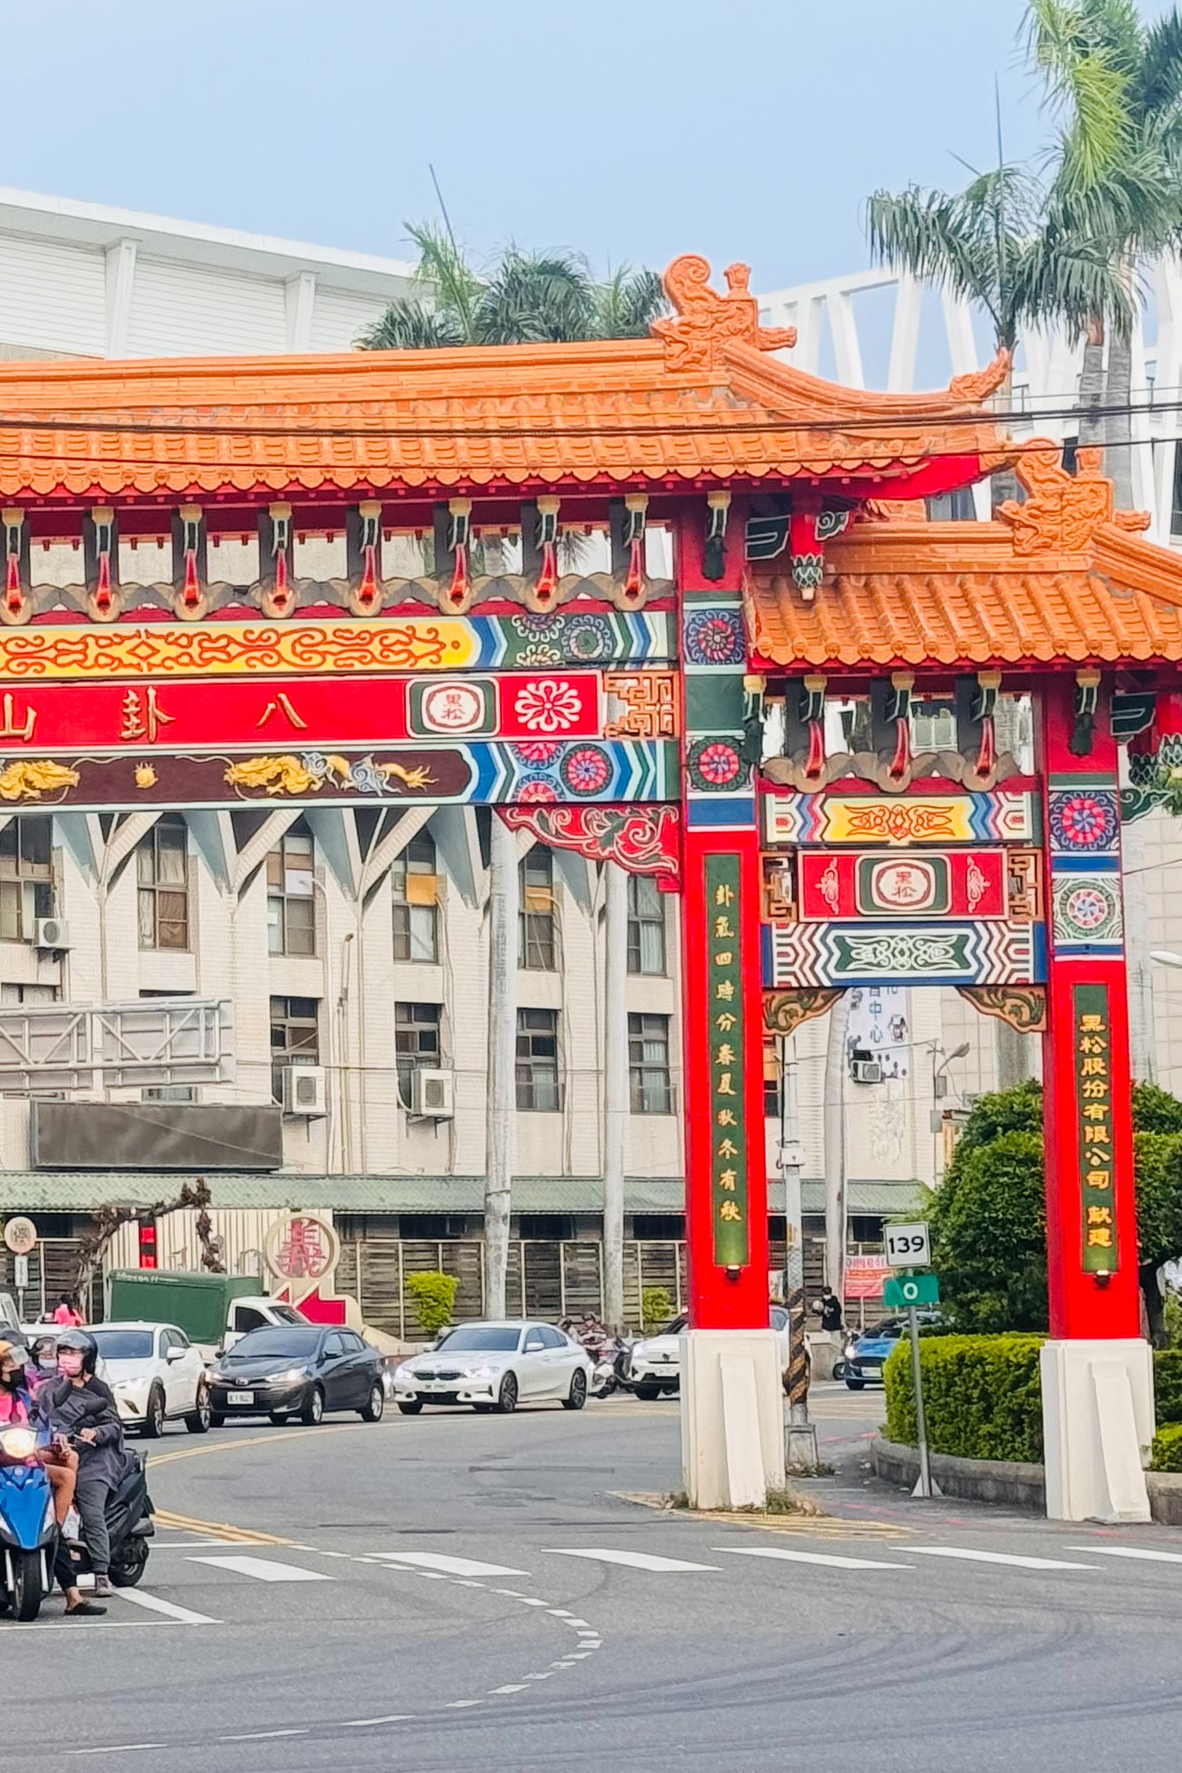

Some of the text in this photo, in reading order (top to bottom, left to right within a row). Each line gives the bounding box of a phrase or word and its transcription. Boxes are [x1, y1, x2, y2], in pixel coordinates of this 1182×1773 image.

[440, 692, 467, 721] 黑松
[891, 871, 917, 899] 黑松
[1079, 1014, 1111, 1190] 黑松股份有限公司
[888, 1235, 925, 1255] 139
